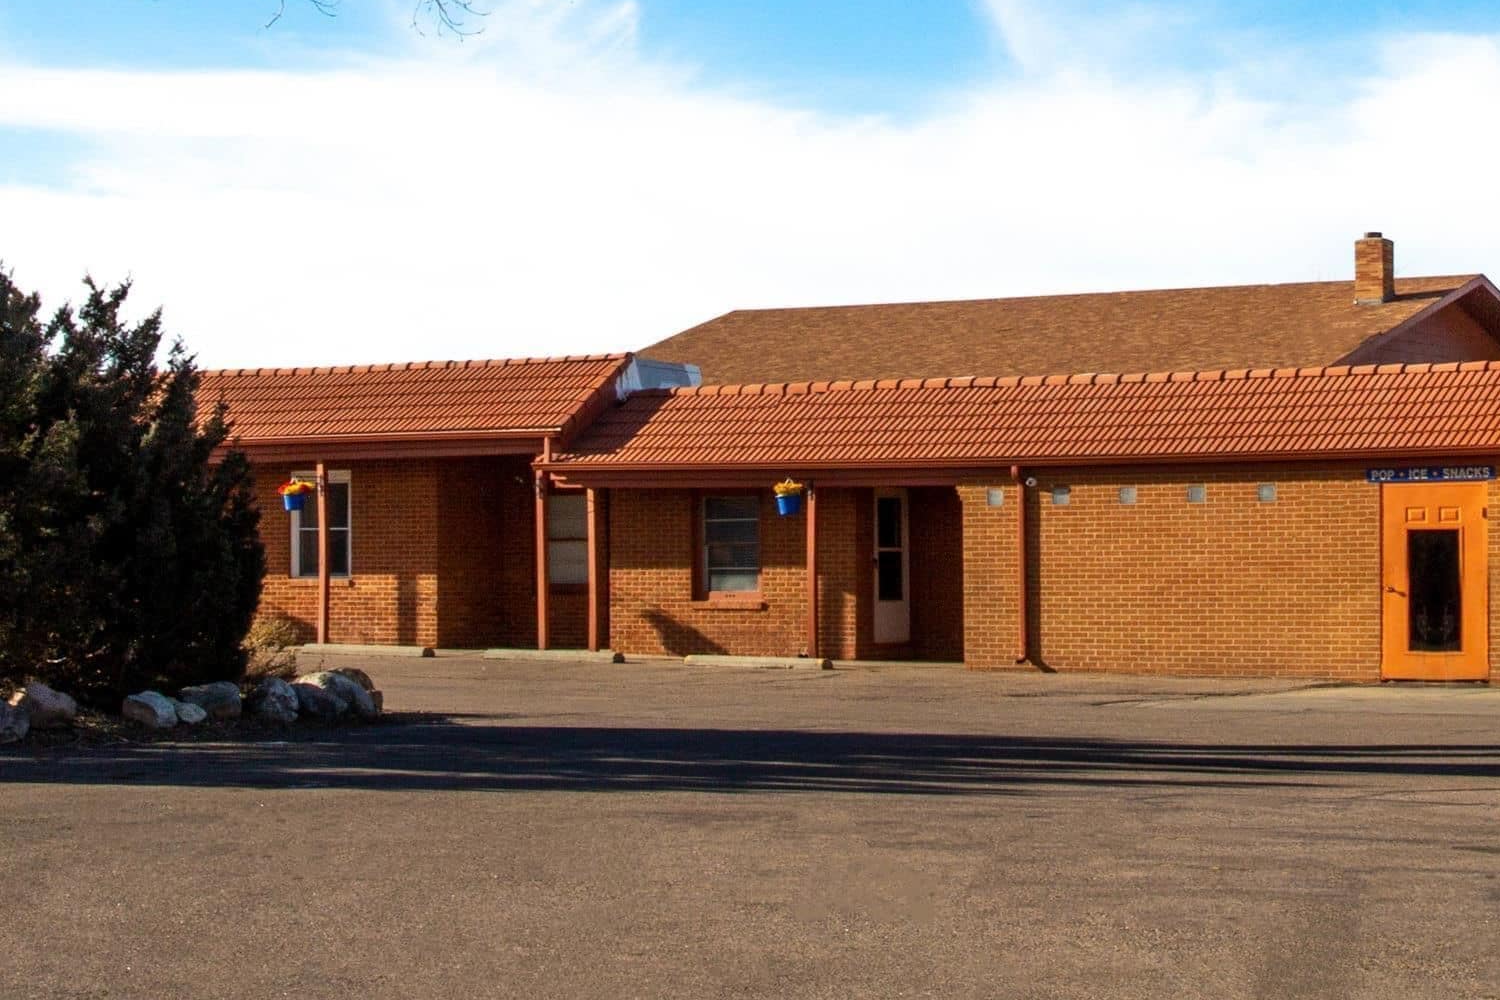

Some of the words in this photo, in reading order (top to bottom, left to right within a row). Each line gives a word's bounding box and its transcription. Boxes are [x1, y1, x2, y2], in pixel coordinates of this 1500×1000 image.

[1370, 469, 1395, 481] POP
[1408, 467, 1428, 480] ICE
[1442, 466, 1490, 479] SNACKS
